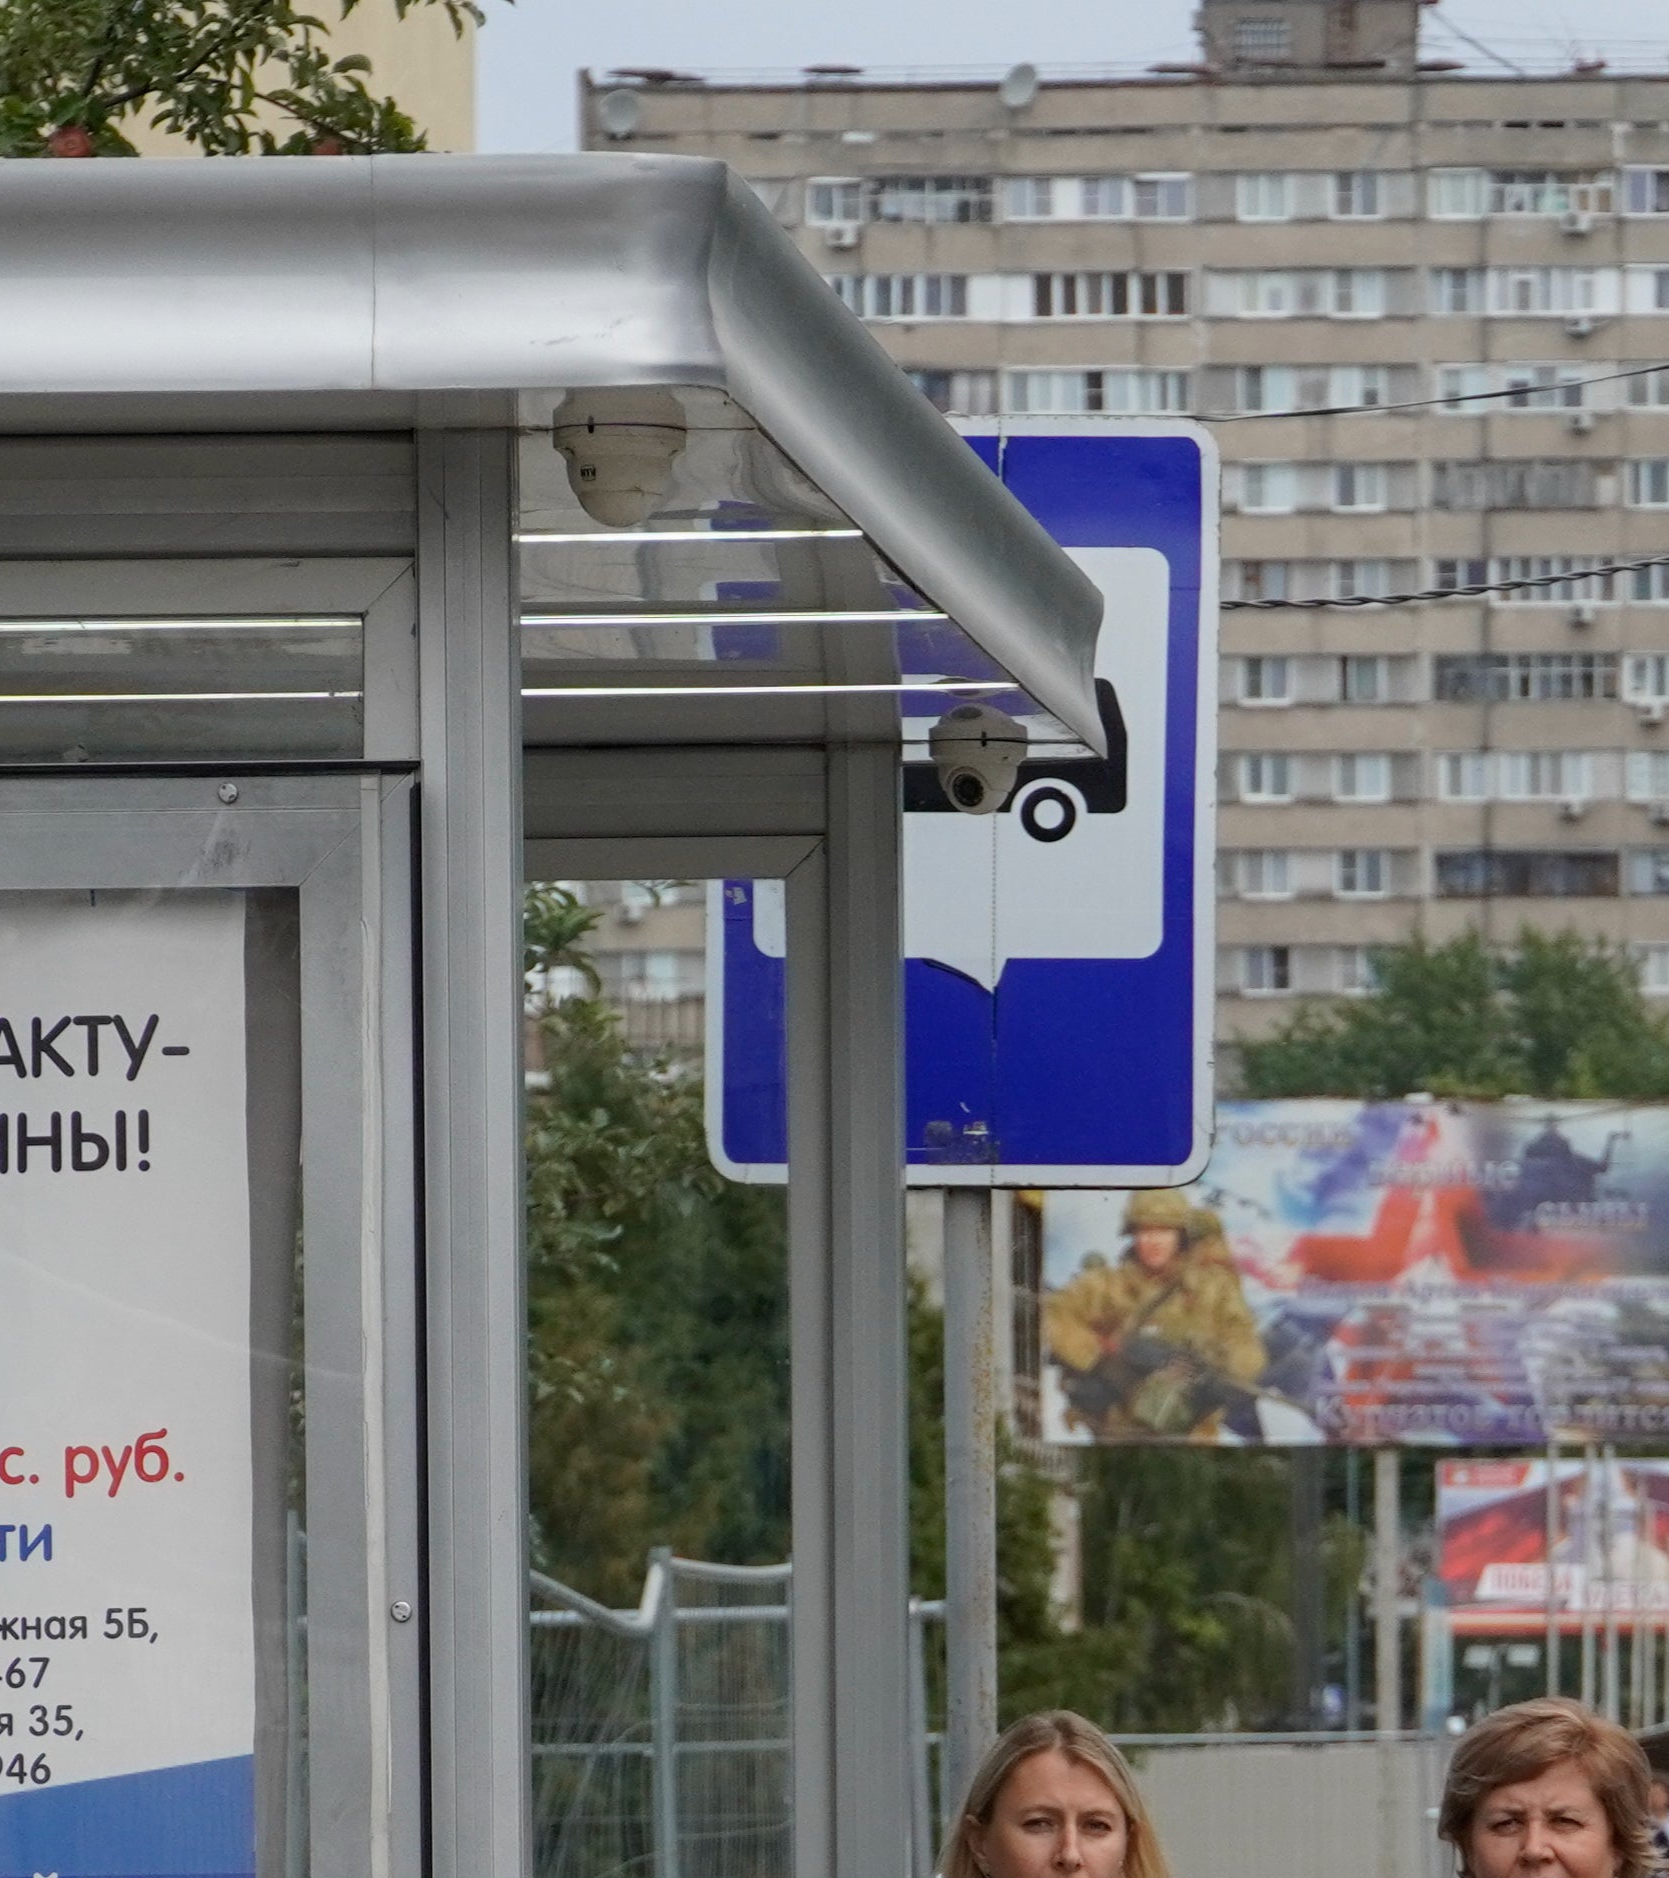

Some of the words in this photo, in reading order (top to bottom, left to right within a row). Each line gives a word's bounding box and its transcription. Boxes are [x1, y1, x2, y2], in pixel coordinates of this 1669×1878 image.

[65, 1428, 184, 1498] руб.
[104, 1608, 158, 1644] 5Б,
[29, 1705, 83, 1741] 35,
